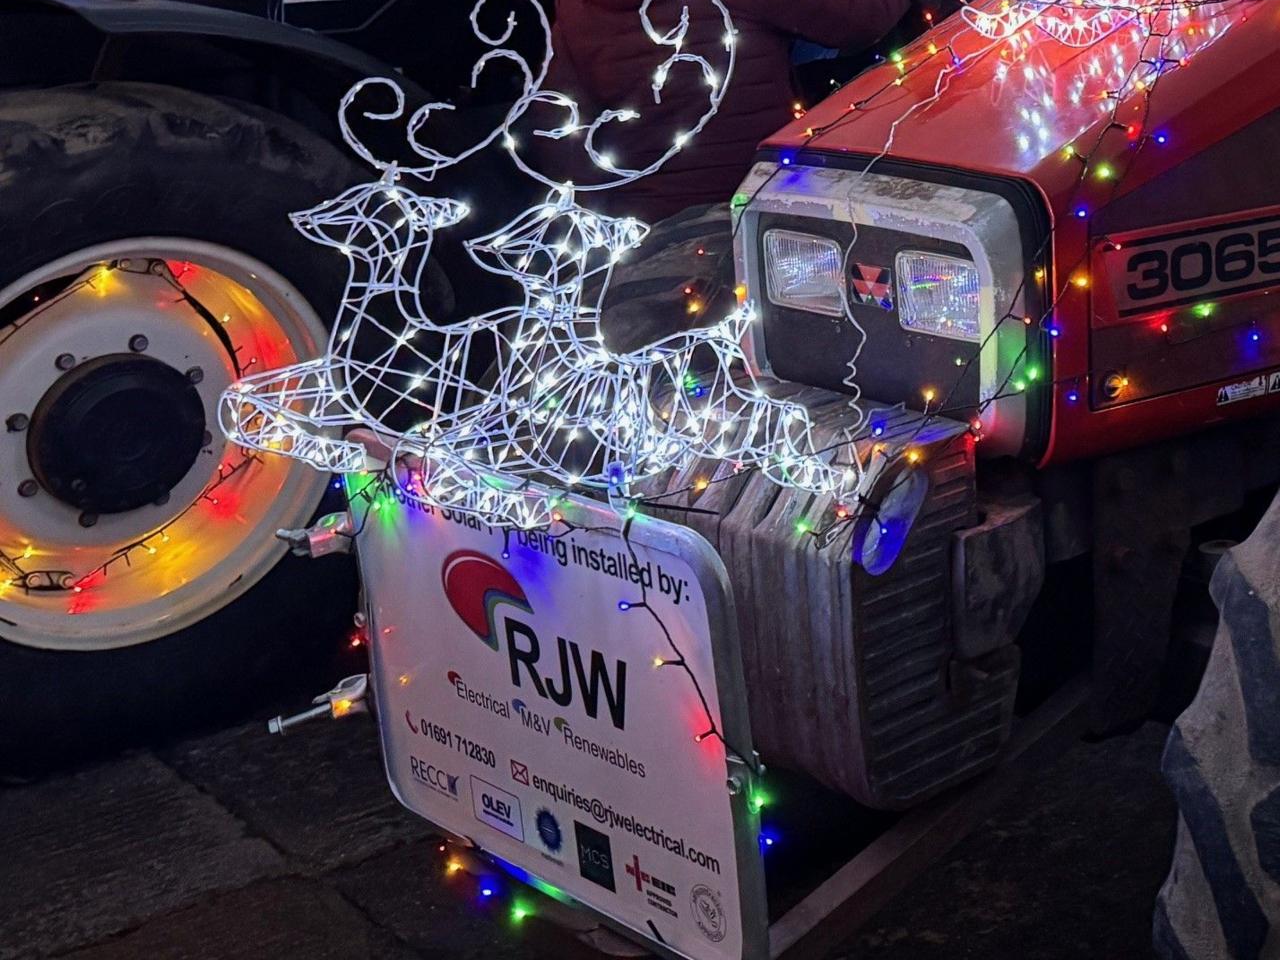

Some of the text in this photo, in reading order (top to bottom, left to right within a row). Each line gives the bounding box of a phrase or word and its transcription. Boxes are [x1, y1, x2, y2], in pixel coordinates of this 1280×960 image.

[517, 524, 568, 566] being
[572, 535, 654, 589] installed
[658, 564, 691, 604] by:
[504, 617, 627, 730] RJW
[421, 718, 496, 768] 01691 712830
[456, 678, 646, 779] Electrical M&V Renewables
[481, 793, 511, 819] OLEV
[532, 774, 721, 875] enquiries@rjwelectrical.com
